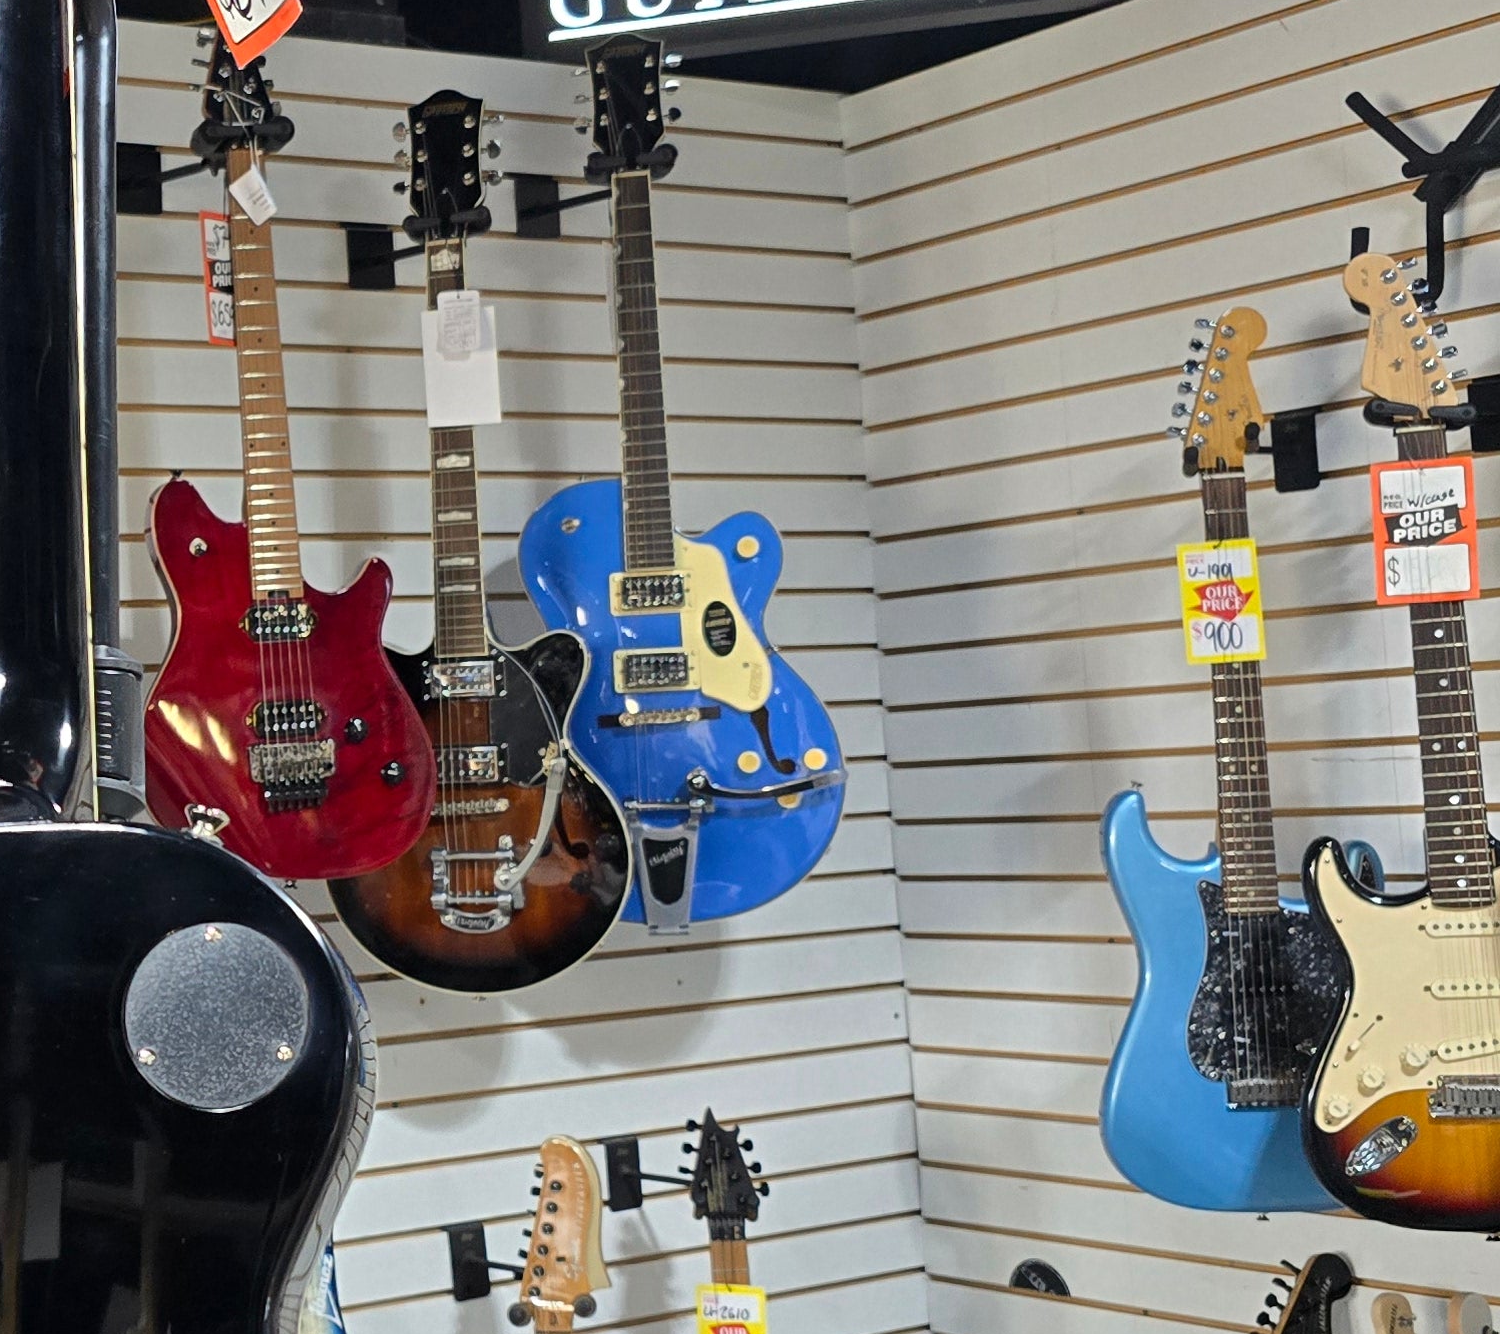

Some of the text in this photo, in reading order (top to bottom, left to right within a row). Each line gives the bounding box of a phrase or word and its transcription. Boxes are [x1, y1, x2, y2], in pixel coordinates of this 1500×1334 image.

[1399, 508, 1445, 529] OUR
[1393, 518, 1457, 543] PRICE
[1205, 584, 1238, 600] OUR
[1202, 597, 1243, 613] PRICE
